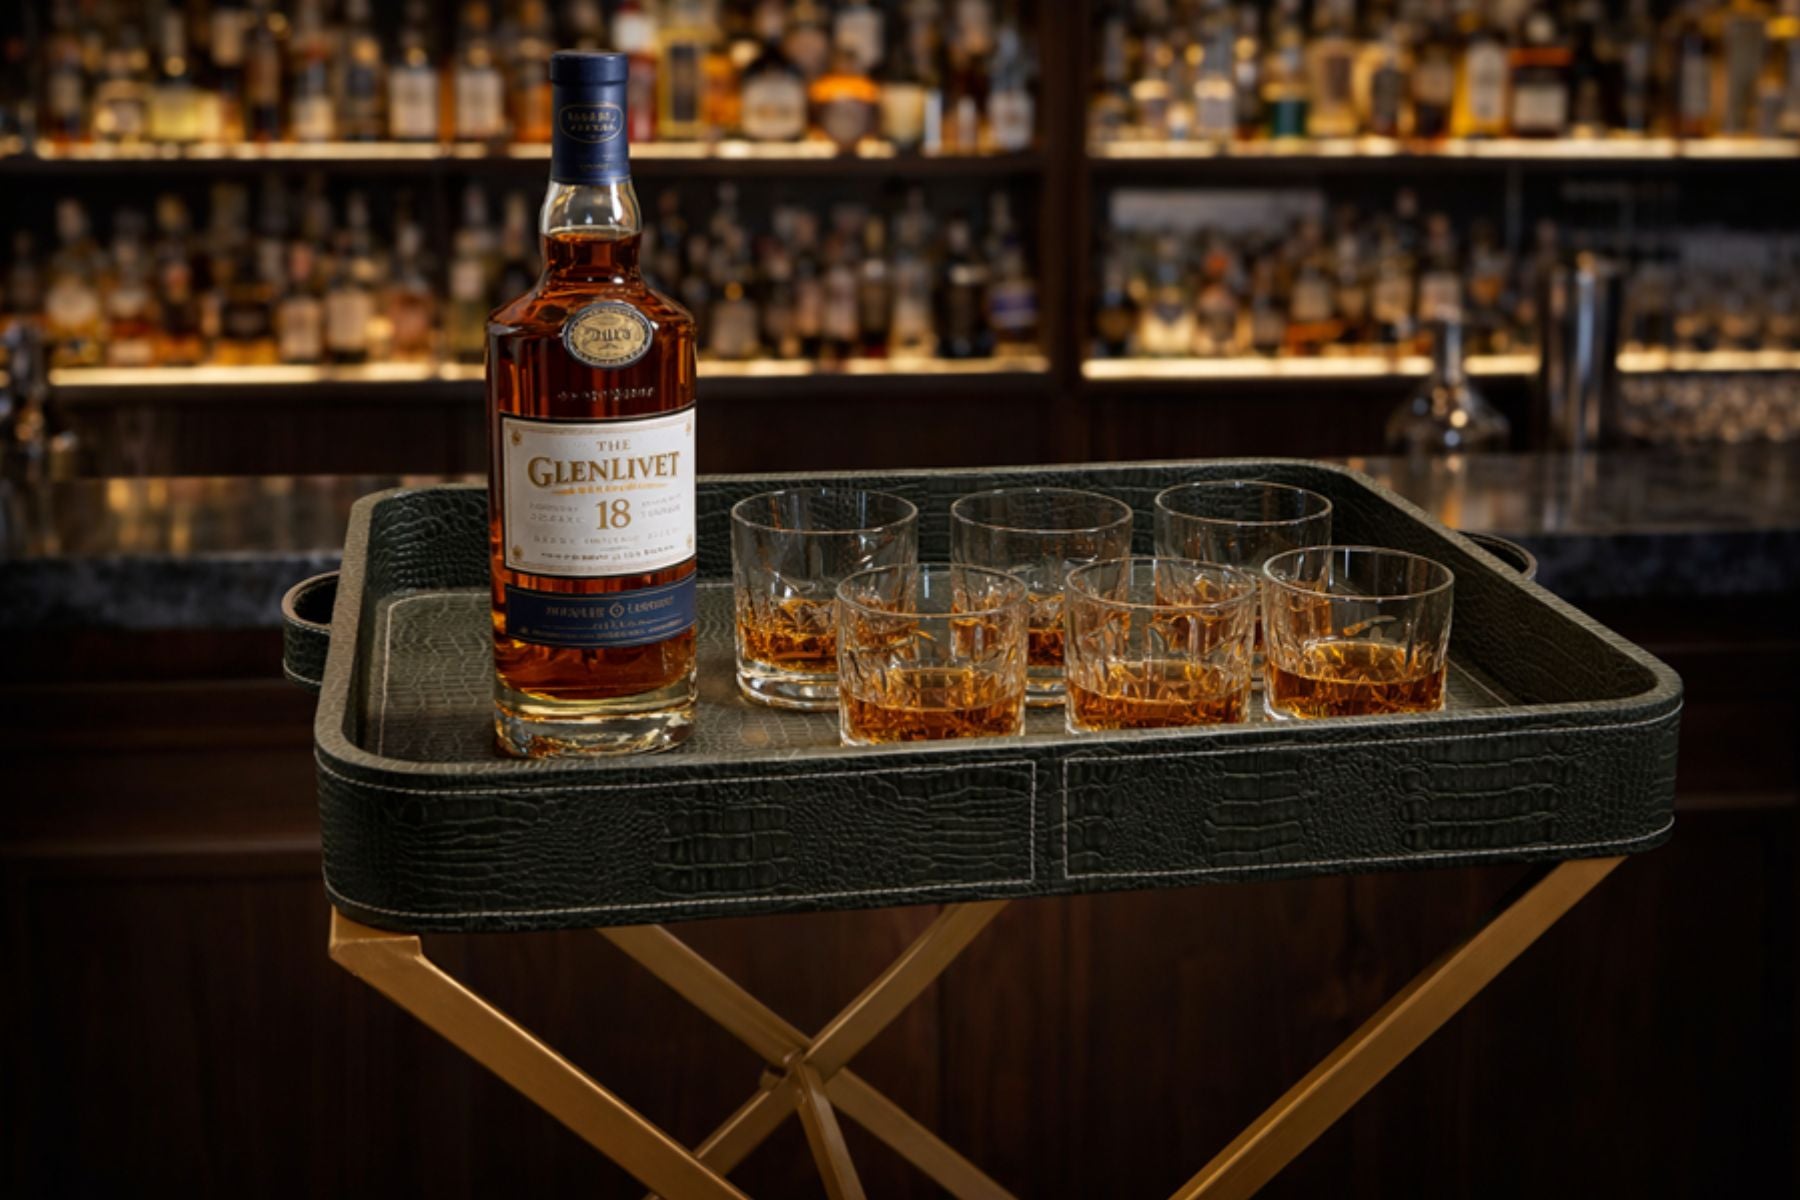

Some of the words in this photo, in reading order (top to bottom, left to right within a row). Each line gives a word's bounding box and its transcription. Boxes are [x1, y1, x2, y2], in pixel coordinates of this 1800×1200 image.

[596, 439, 631, 452] THE
[527, 451, 680, 489] GLENLIVET
[595, 498, 632, 530] 18
